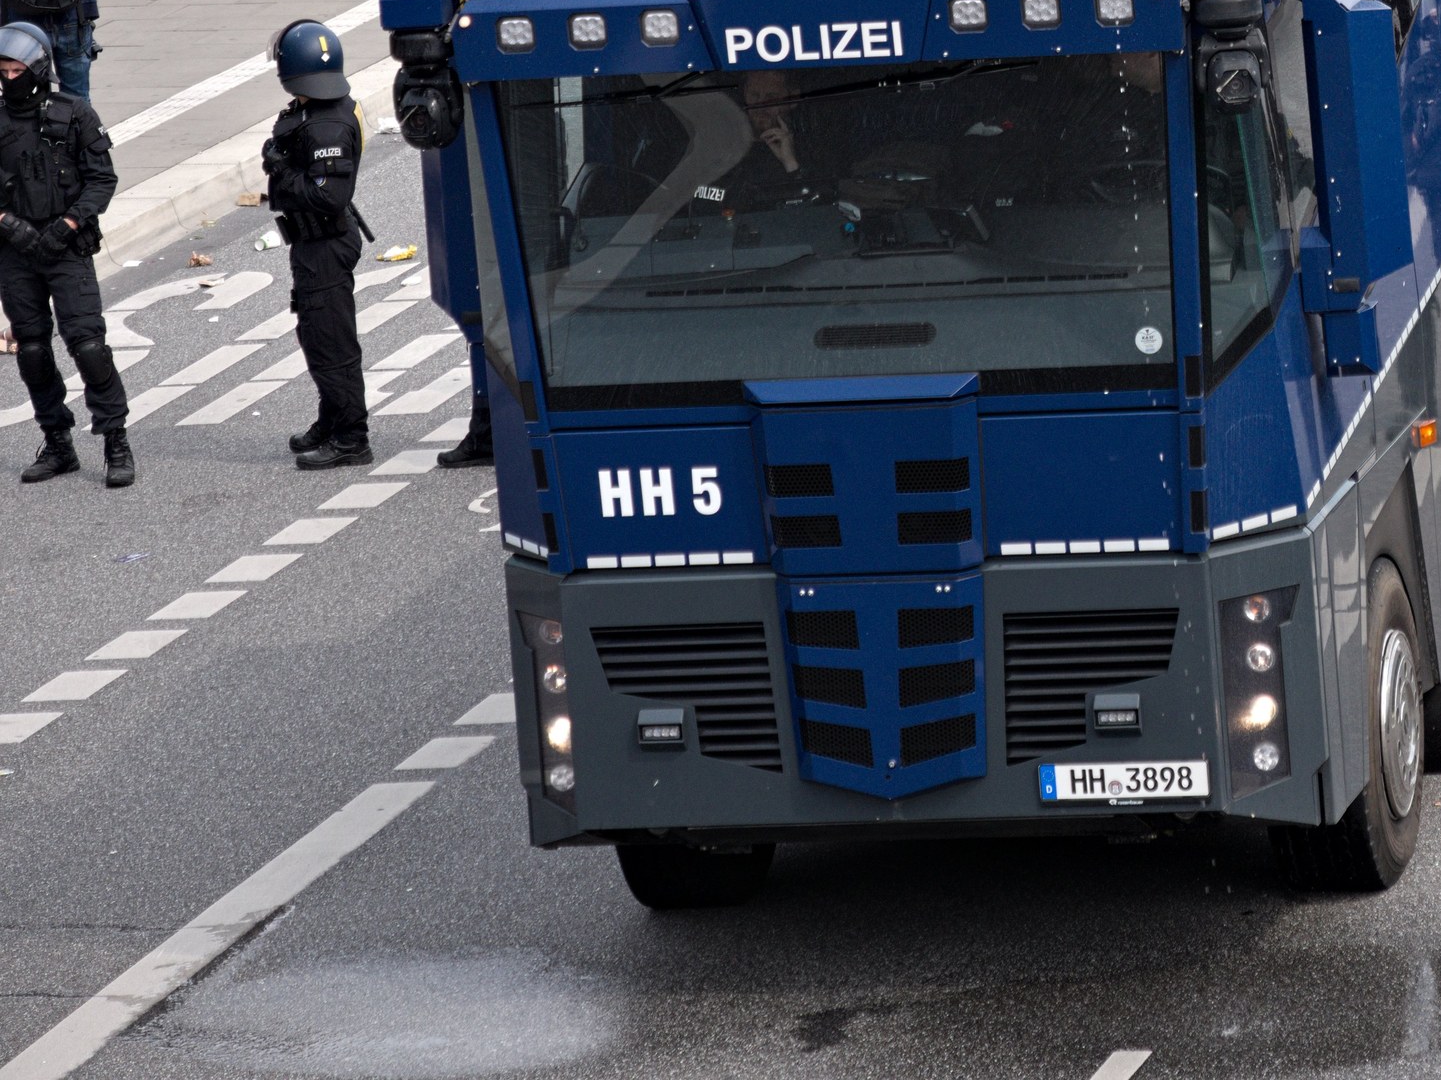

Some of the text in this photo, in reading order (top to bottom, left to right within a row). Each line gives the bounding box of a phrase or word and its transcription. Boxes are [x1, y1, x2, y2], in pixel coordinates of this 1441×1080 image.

[725, 21, 904, 64] POLIZEI
[314, 147, 342, 160] POLIZEI
[694, 185, 725, 202] POLIZEI
[598, 466, 722, 518] HH 5
[1046, 785, 1053, 794] D
[1070, 766, 1193, 795] HH 3898
